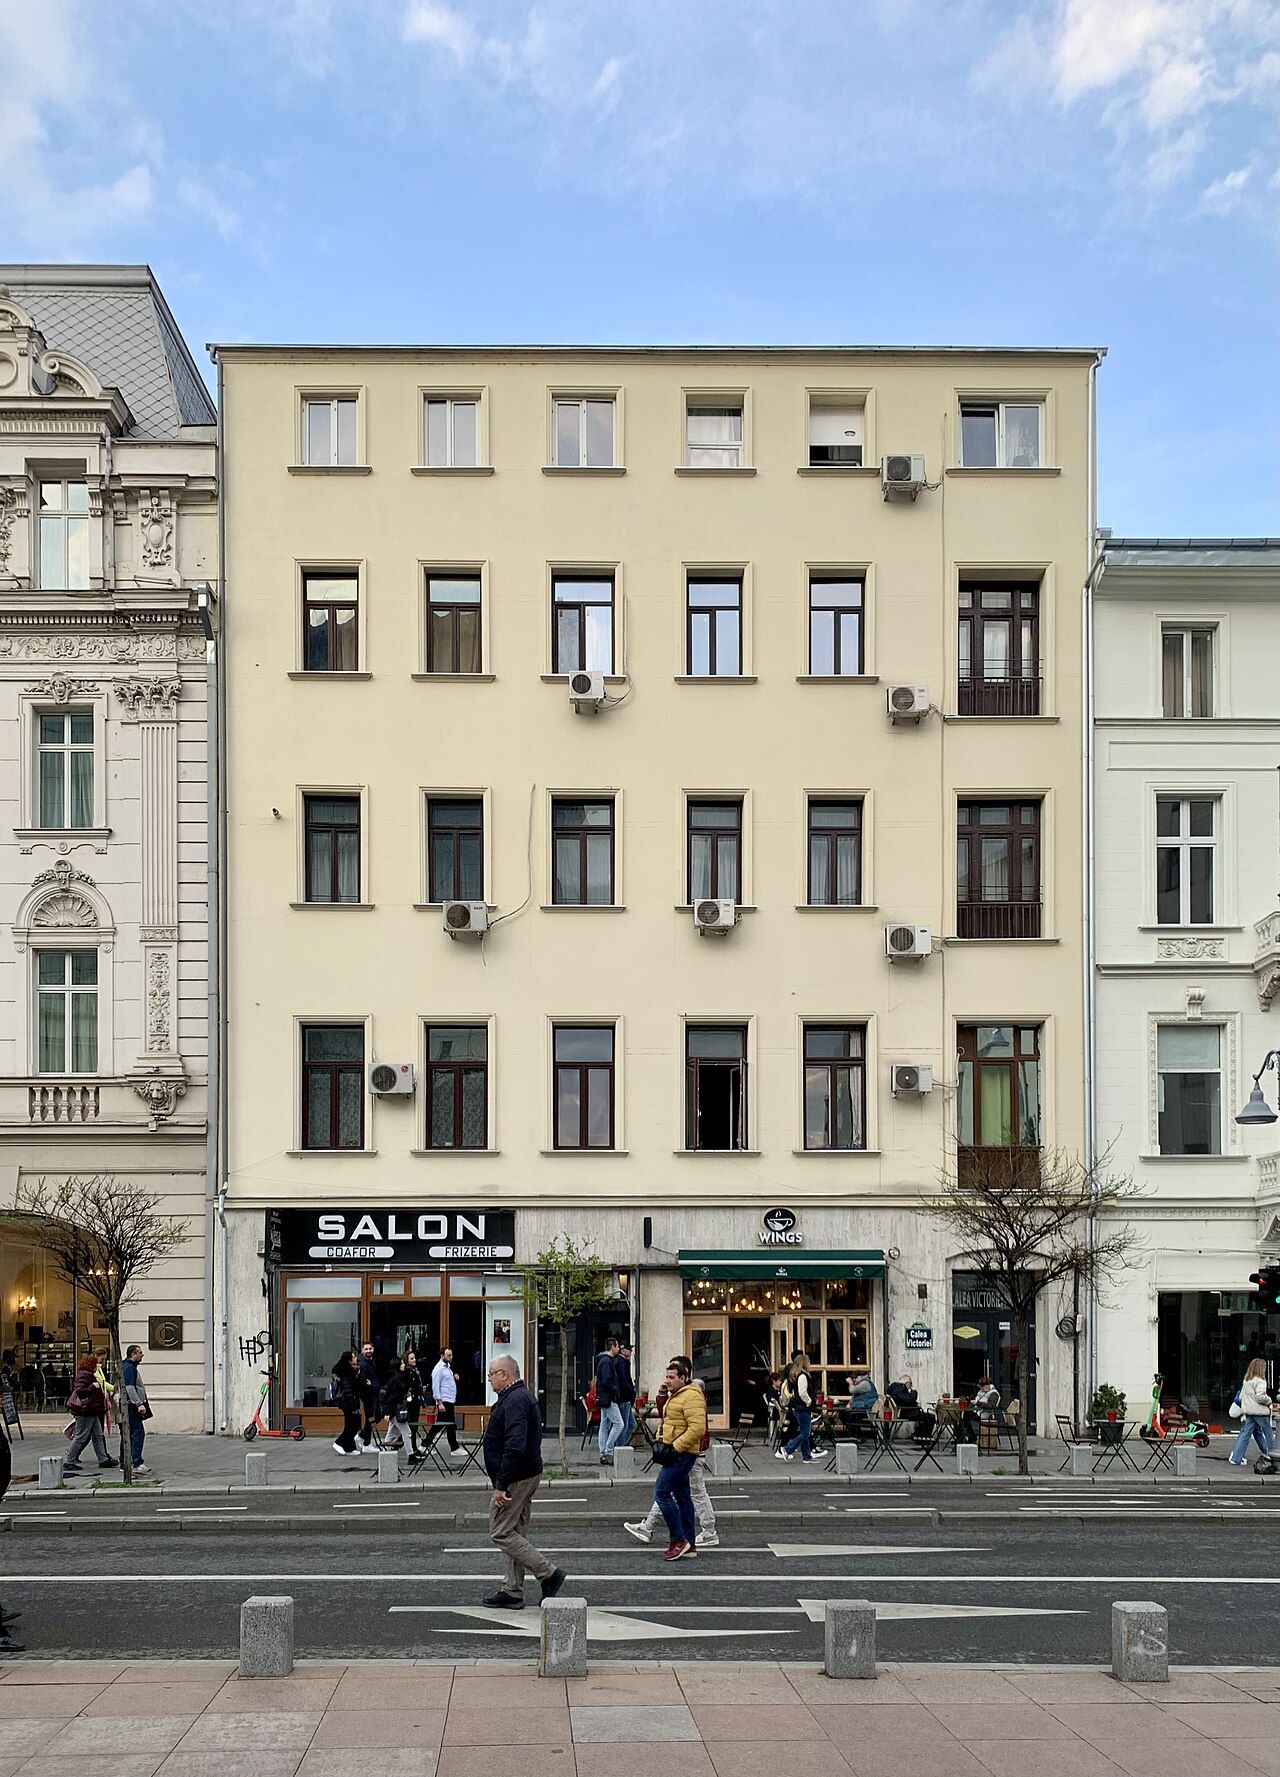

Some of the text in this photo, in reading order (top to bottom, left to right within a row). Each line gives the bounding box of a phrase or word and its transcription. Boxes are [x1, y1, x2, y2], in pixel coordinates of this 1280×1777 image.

[317, 1215, 486, 1240] SALON
[758, 1231, 803, 1243] WINGS
[326, 1247, 376, 1258] COAFOR
[445, 1246, 497, 1257] FRIZERIE
[910, 1330, 928, 1338] Calea
[906, 1339, 932, 1348] Victoriei
